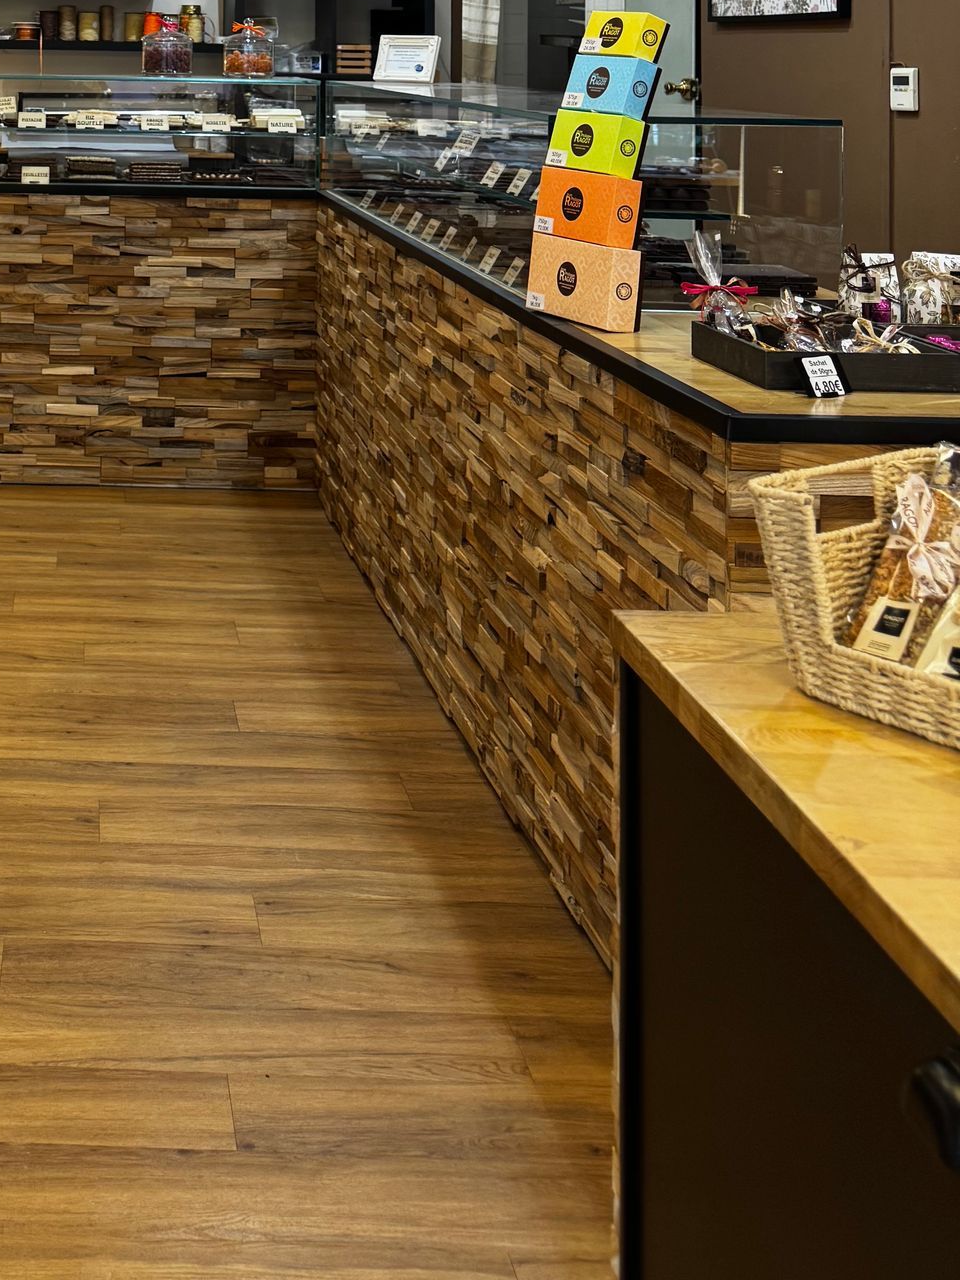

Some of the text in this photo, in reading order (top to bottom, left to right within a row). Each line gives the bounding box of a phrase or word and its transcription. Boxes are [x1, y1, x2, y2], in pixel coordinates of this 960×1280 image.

[602, 25, 621, 36] RAGOT
[589, 75, 607, 86] RAGOT
[574, 132, 591, 144] RAGOT
[564, 195, 581, 208] RAGOT
[559, 270, 575, 284] RAGOT
[814, 380, 842, 393] 4.80€
[901, 496, 919, 529] RAGOT
